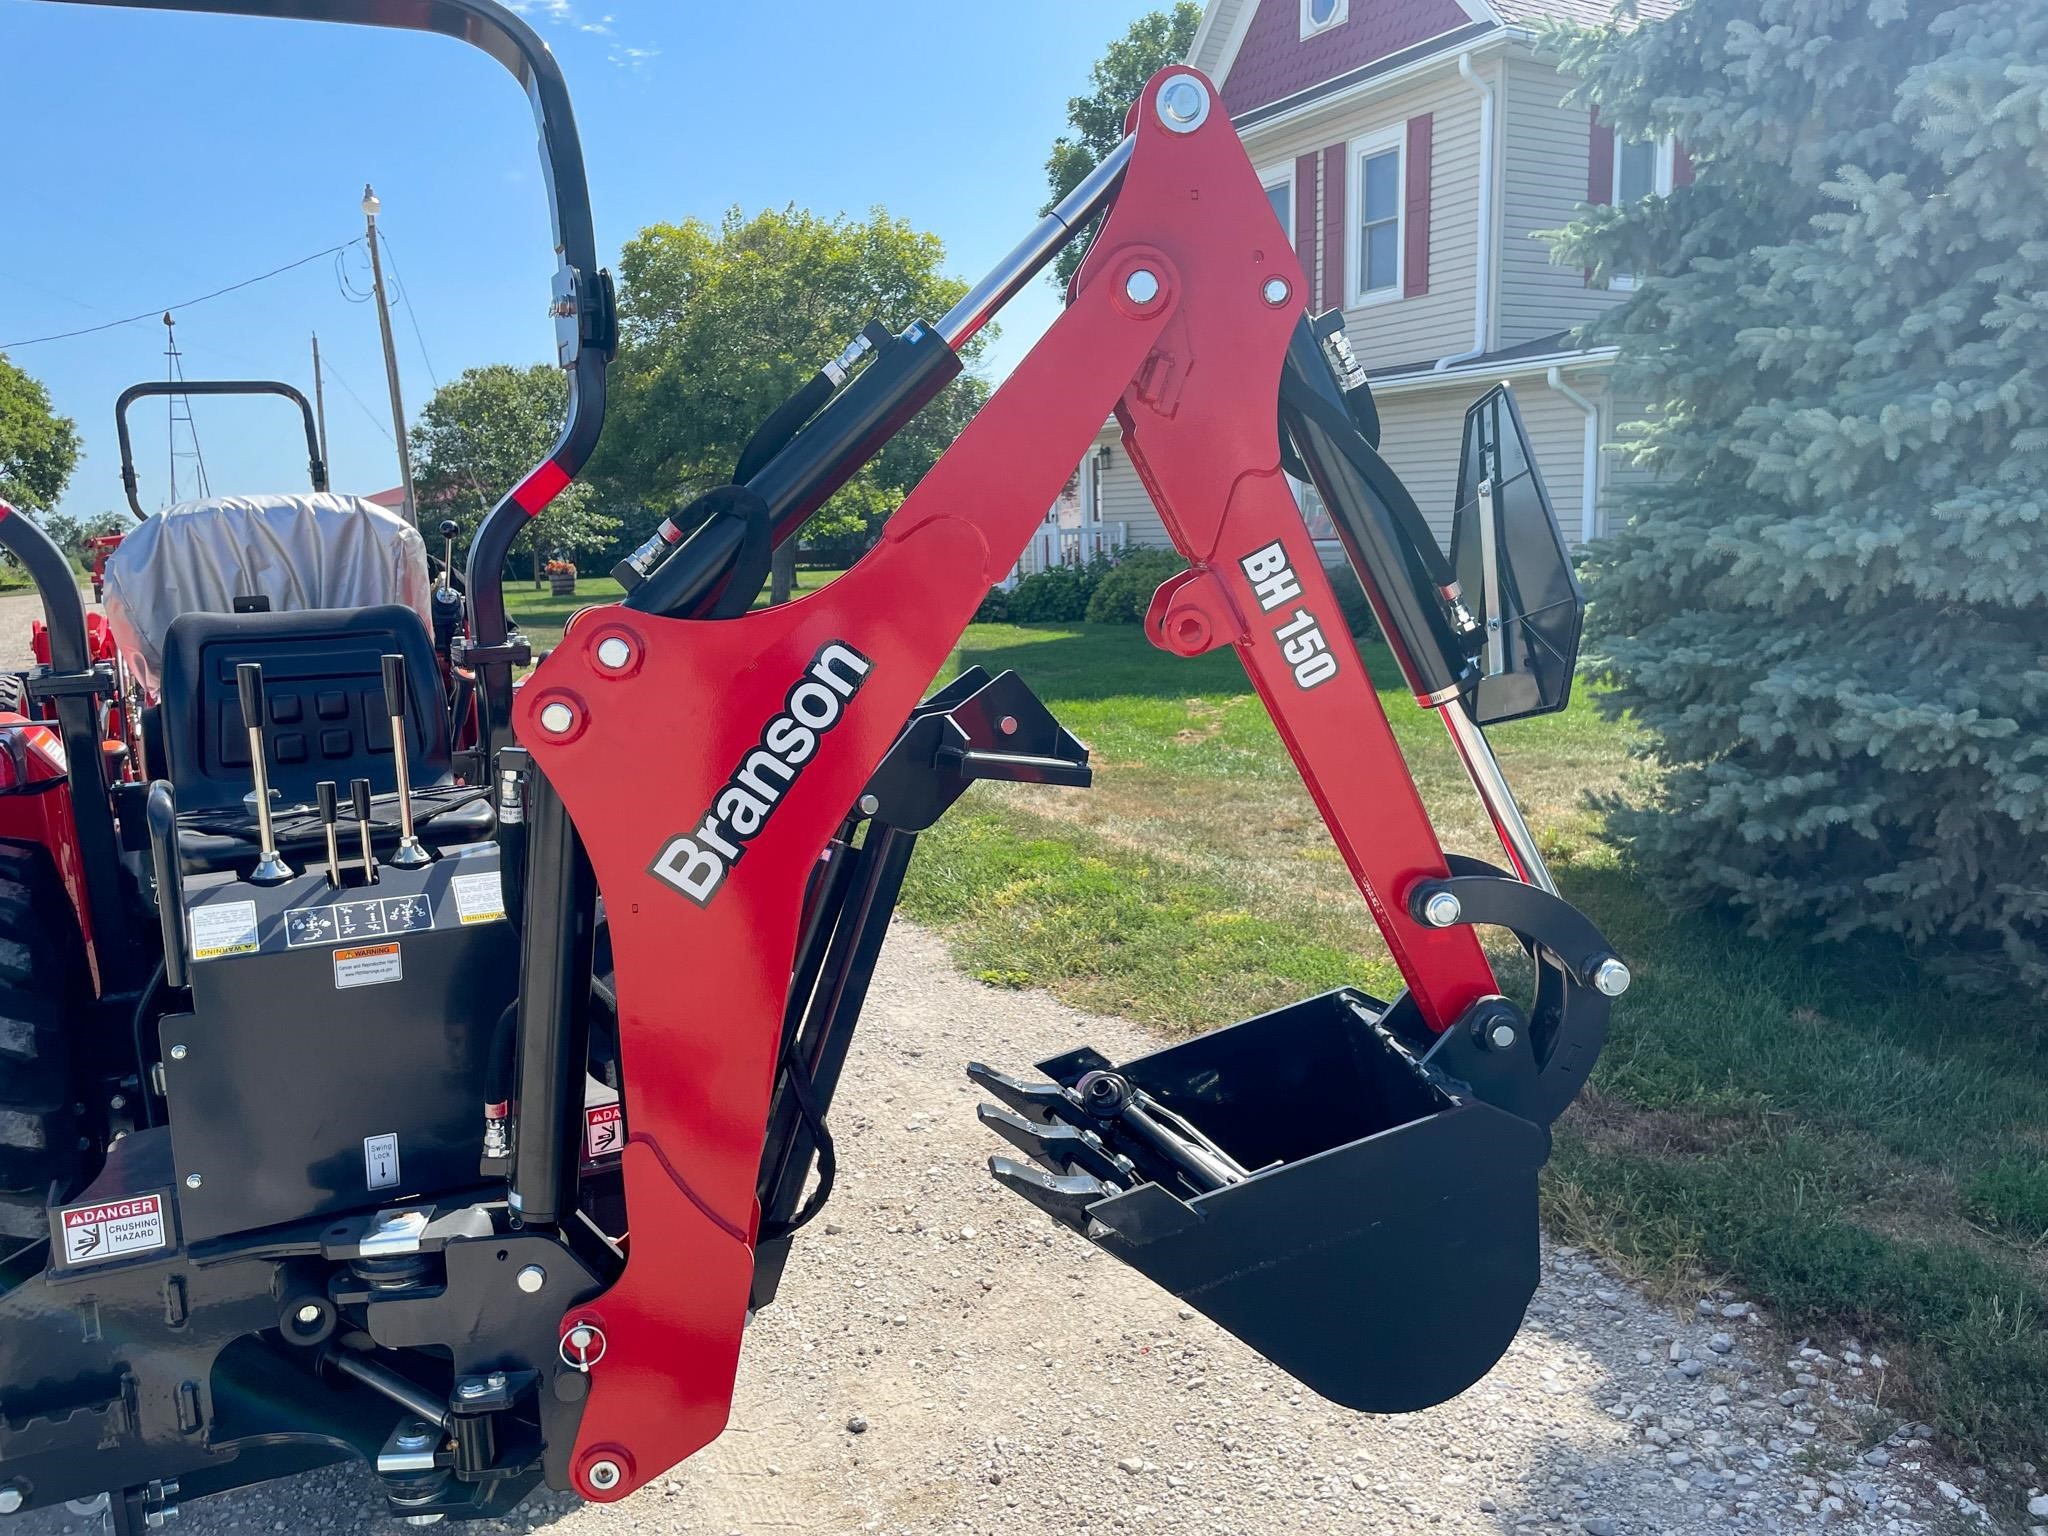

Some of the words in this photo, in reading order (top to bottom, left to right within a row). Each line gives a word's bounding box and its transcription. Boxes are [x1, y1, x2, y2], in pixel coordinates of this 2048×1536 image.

[1241, 542, 1302, 611] BH
[1275, 609, 1337, 688] 150
[652, 643, 870, 903] Branson
[200, 946, 242, 956] WARNING
[354, 946, 390, 957] WARNING
[371, 1143, 393, 1153] Swing
[373, 1152, 391, 1160] Lock
[84, 1200, 153, 1223] DANGER
[108, 1218, 158, 1234] CRUSHING
[115, 1229, 154, 1243] HAZARD
